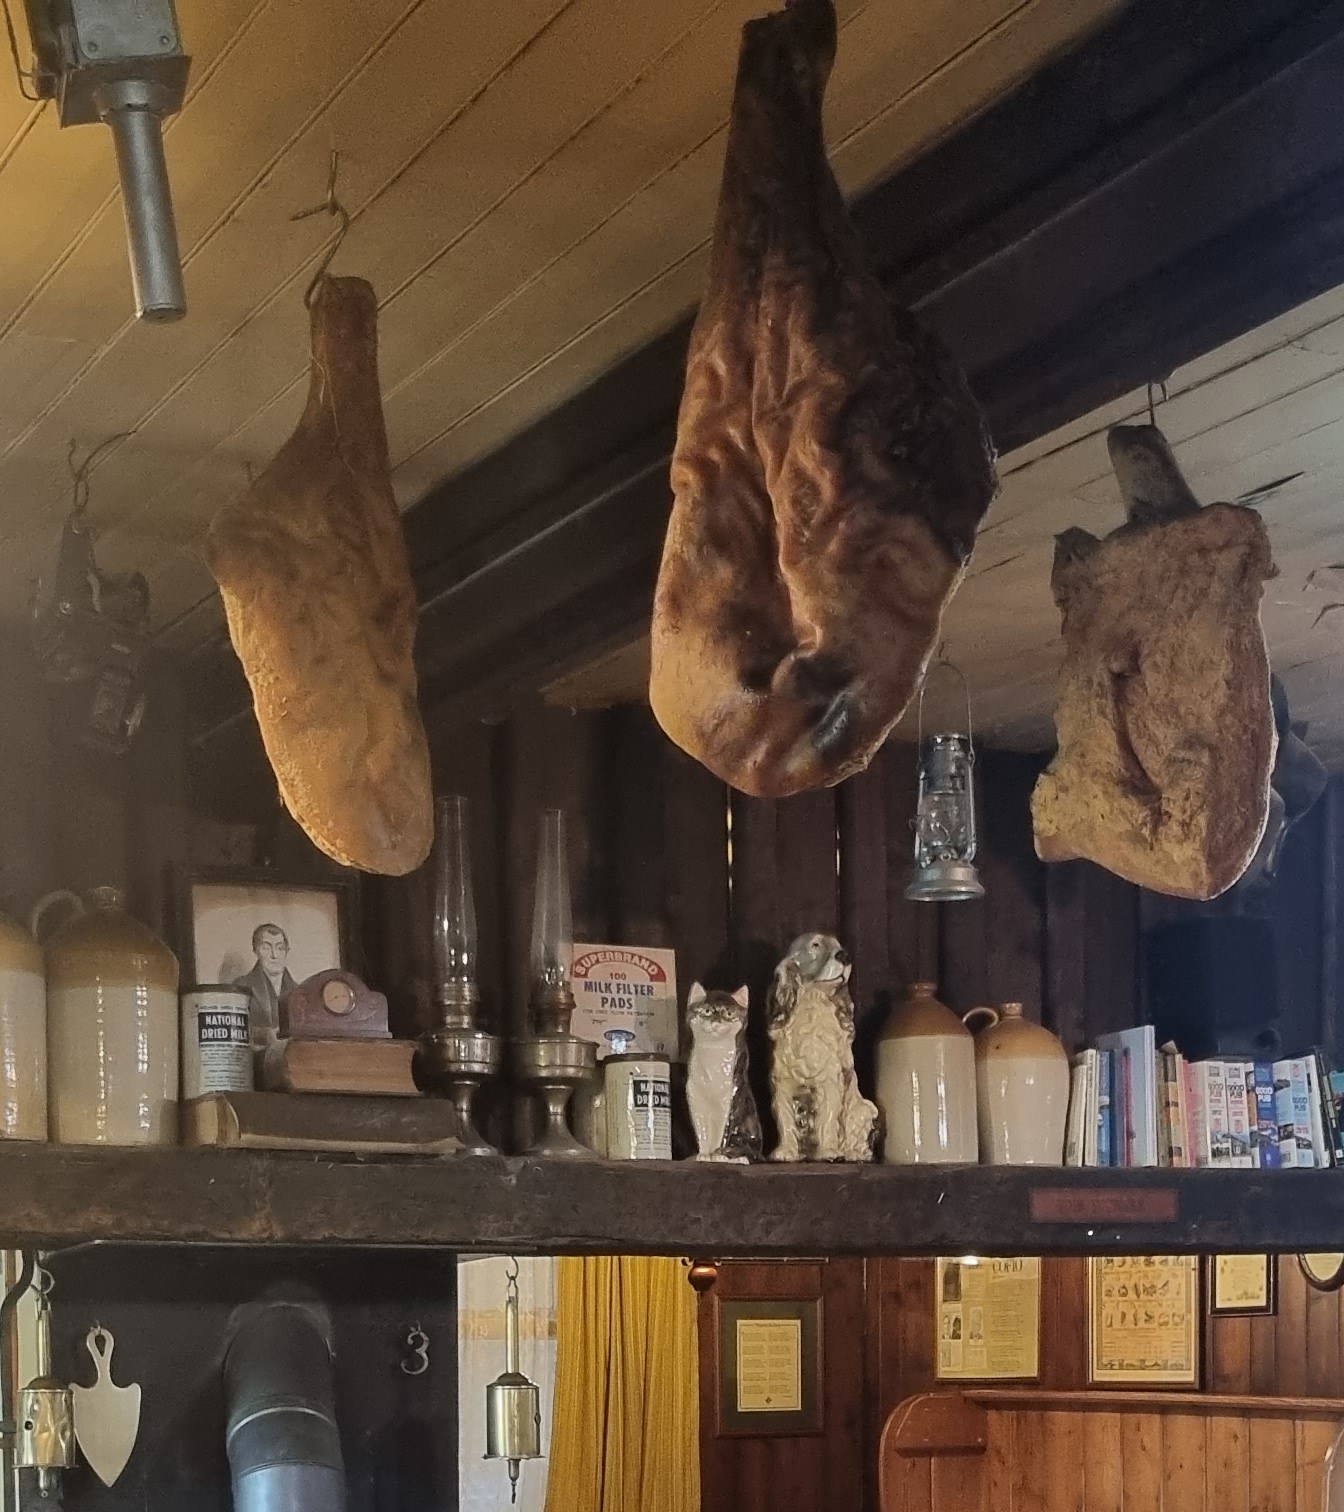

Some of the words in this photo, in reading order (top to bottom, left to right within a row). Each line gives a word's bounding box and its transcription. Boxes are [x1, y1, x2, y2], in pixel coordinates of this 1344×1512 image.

[575, 951, 659, 976] SUPERBRAND
[609, 972, 627, 980] 100
[584, 981, 613, 994] MILK
[616, 982, 654, 996] FILTER
[601, 997, 633, 1010] PADS
[205, 1014, 246, 1027] NATIONAL
[201, 1028, 229, 1039] DRIED
[230, 1028, 248, 1040] MILK
